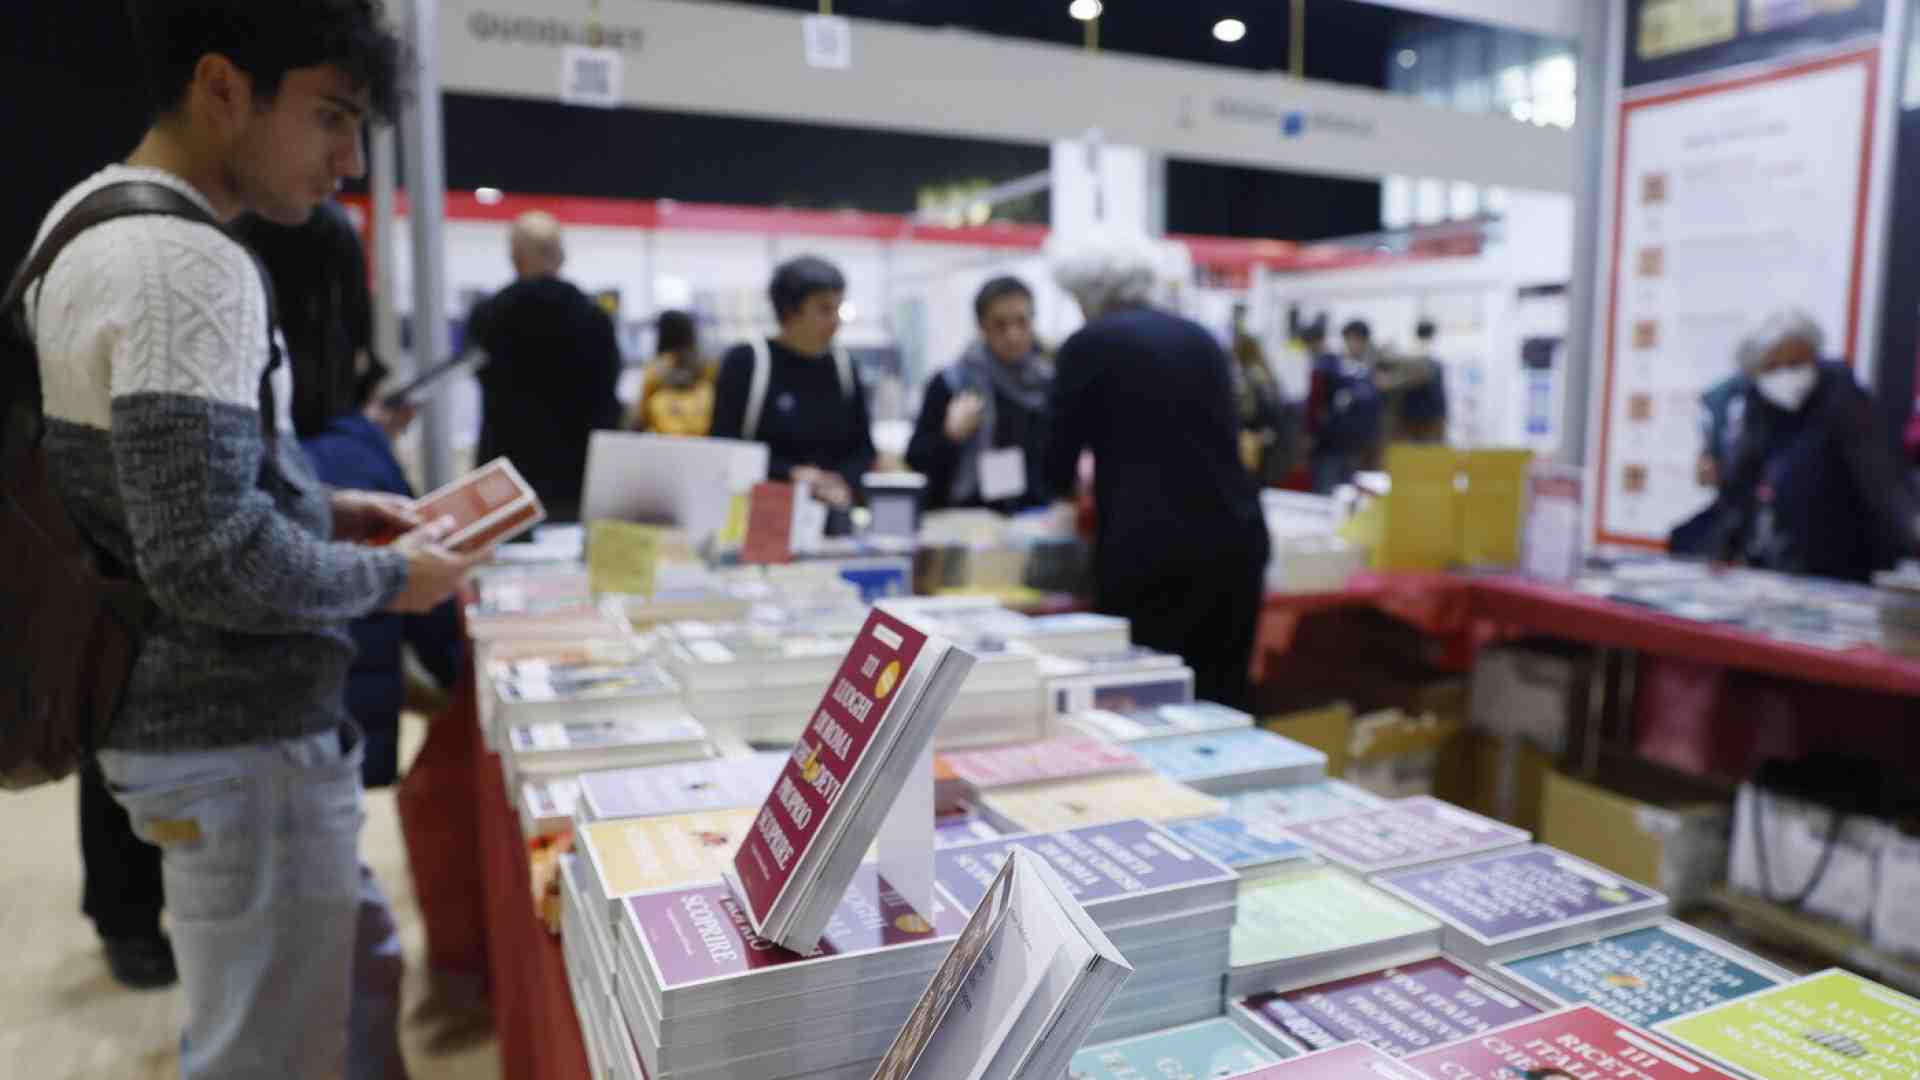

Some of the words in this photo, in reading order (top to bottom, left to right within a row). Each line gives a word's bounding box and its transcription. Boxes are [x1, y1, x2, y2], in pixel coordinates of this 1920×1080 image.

[832, 677, 874, 723] LUOGHI
[825, 717, 853, 762] ROMA
[757, 803, 794, 871] SCOPRIRE
[680, 894, 738, 964] SCOPRIRE
[1524, 1039, 1600, 1080] ITALI
[1618, 1046, 1660, 1068] 111
